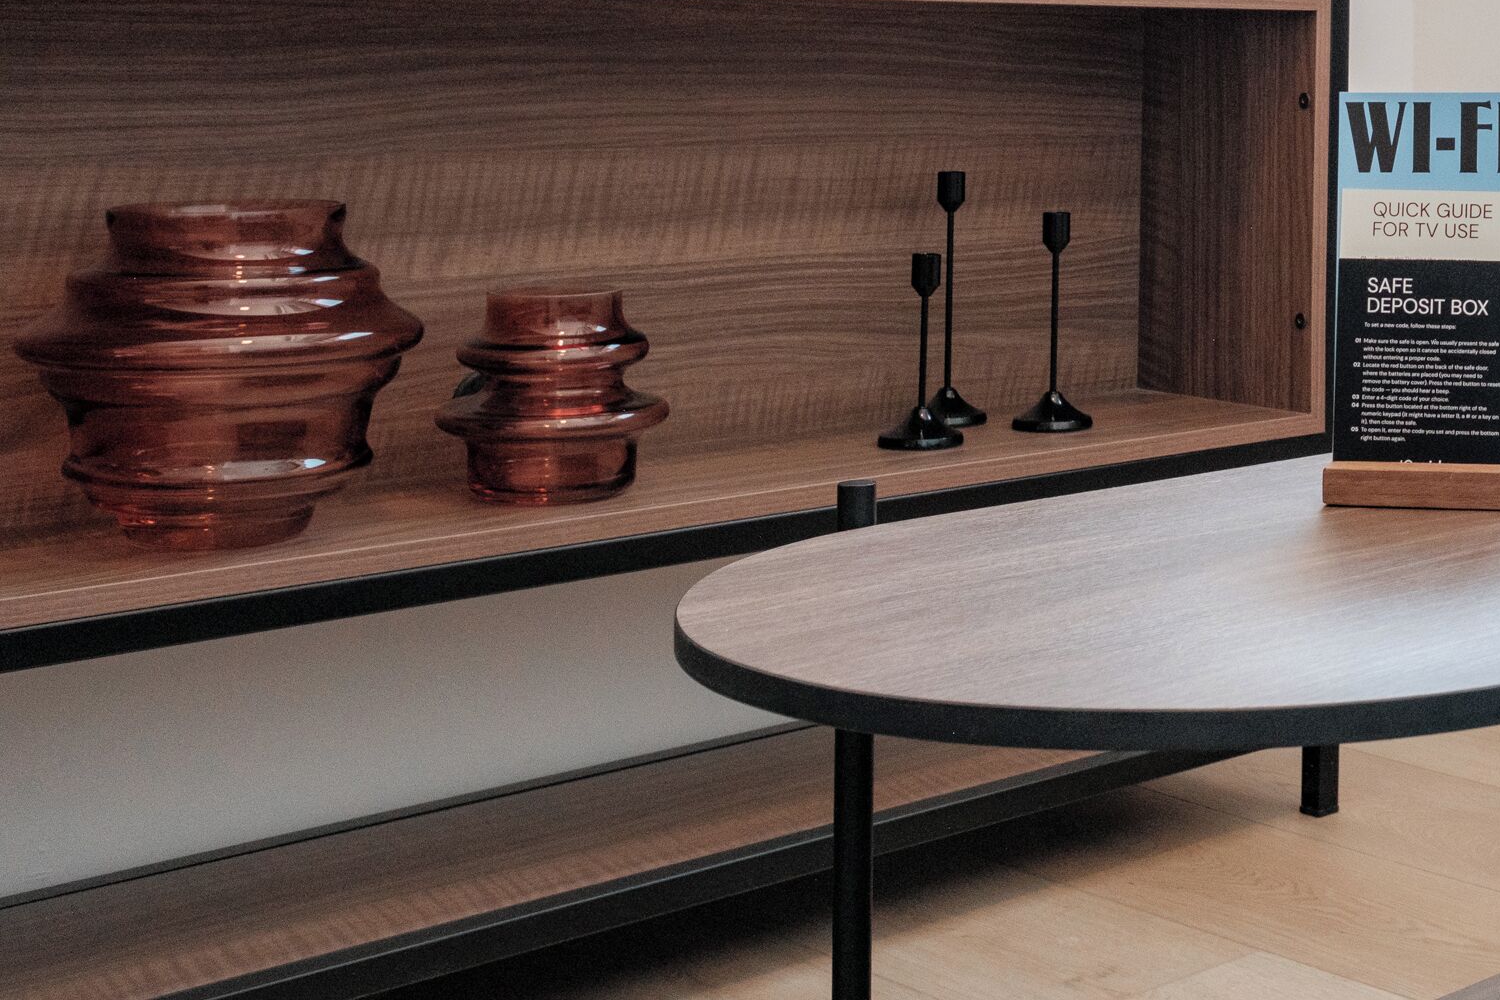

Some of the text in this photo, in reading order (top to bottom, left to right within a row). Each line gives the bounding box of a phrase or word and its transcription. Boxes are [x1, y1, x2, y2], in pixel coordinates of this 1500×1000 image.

[1373, 202, 1493, 219] QUICK GUIDE
[1372, 222, 1479, 239] FOR TV USE
[1367, 277, 1413, 294] SAFE
[1367, 297, 1489, 316] DEPOSIT BOX
